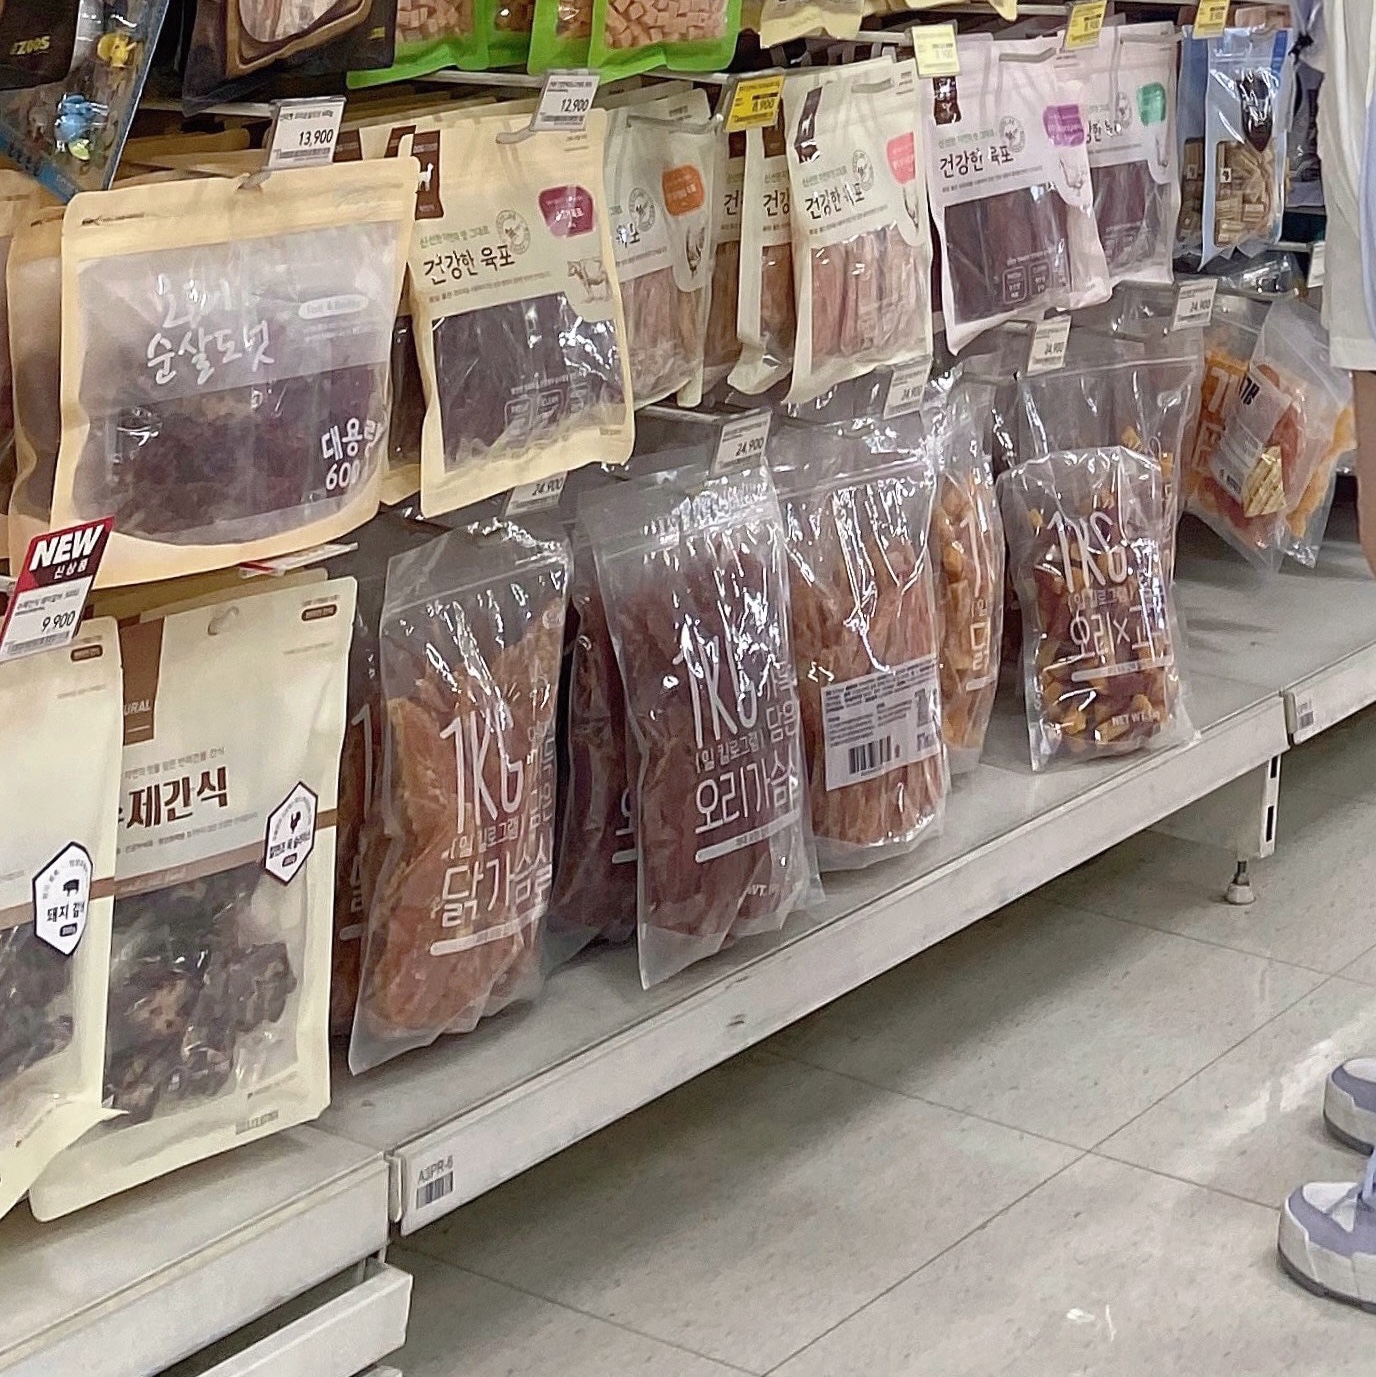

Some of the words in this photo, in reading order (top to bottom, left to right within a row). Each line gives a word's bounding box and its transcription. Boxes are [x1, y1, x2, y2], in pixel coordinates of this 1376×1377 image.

[560, 98, 590, 114] 12,900
[298, 128, 335, 147] 13,900
[938, 148, 983, 179] 건강한
[804, 192, 842, 220] 건강한
[423, 249, 479, 285] 건강한
[480, 244, 515, 272] 육포
[29, 523, 102, 572] NEW
[53, 557, 90, 580] 신상품
